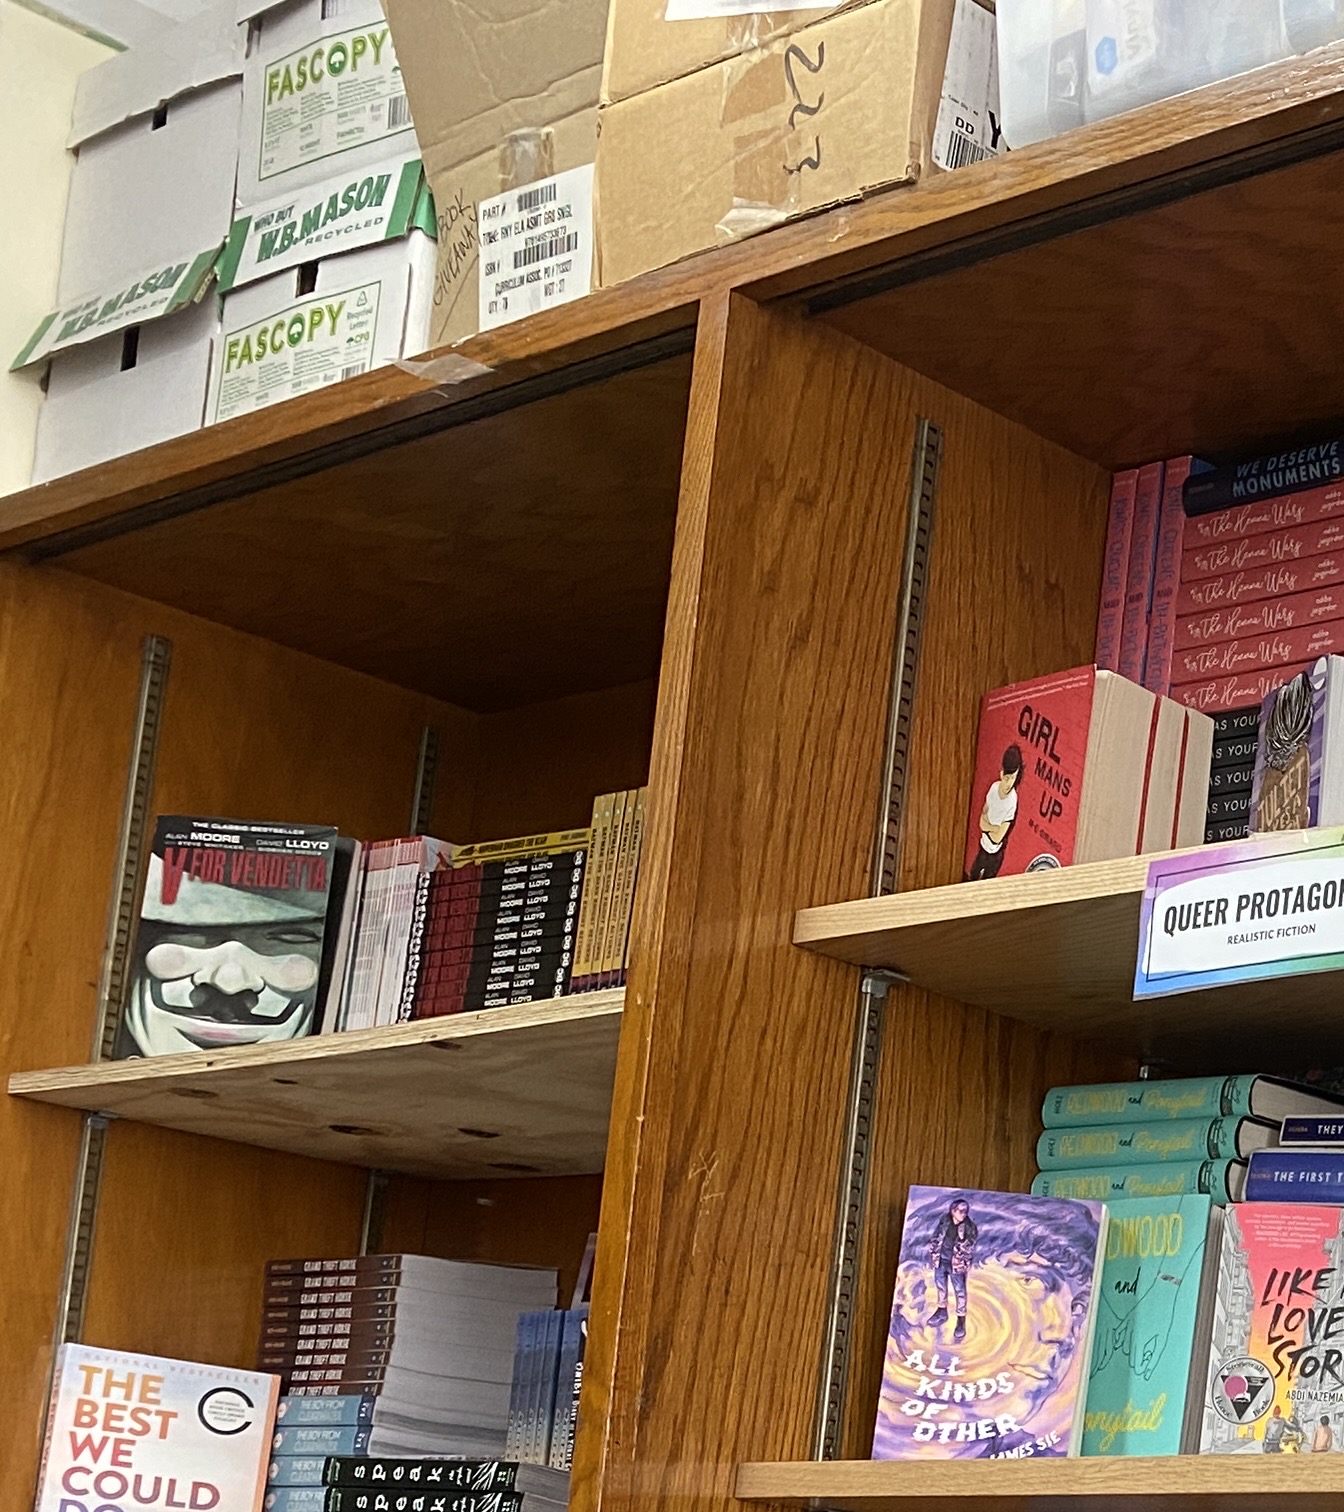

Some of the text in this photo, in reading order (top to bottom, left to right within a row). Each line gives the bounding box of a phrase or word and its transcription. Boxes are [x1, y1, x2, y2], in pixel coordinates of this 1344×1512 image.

[267, 28, 390, 105] FASCOPY
[305, 216, 383, 246] RECYCLED
[225, 301, 346, 373] FASCOPY
[1018, 704, 1061, 764] GIRL
[1034, 756, 1073, 799] MANS
[1039, 797, 1063, 825] UP
[189, 855, 224, 884] FOR
[228, 856, 327, 892] VENDETTA
[1164, 897, 1229, 937] QUEER
[1227, 923, 1316, 945] REALISTIC FICTION
[1262, 1266, 1338, 1308] LIKE
[902, 1348, 961, 1376] ALL
[78, 1364, 165, 1405] THE
[914, 1374, 1015, 1400] KINDS
[1285, 1389, 1305, 1402] ABDI
[73, 1404, 178, 1440] BEST
[901, 1399, 948, 1422] OF
[912, 1414, 1020, 1444] OTHER
[68, 1432, 134, 1468] WE
[61, 1467, 221, 1512] COULD
